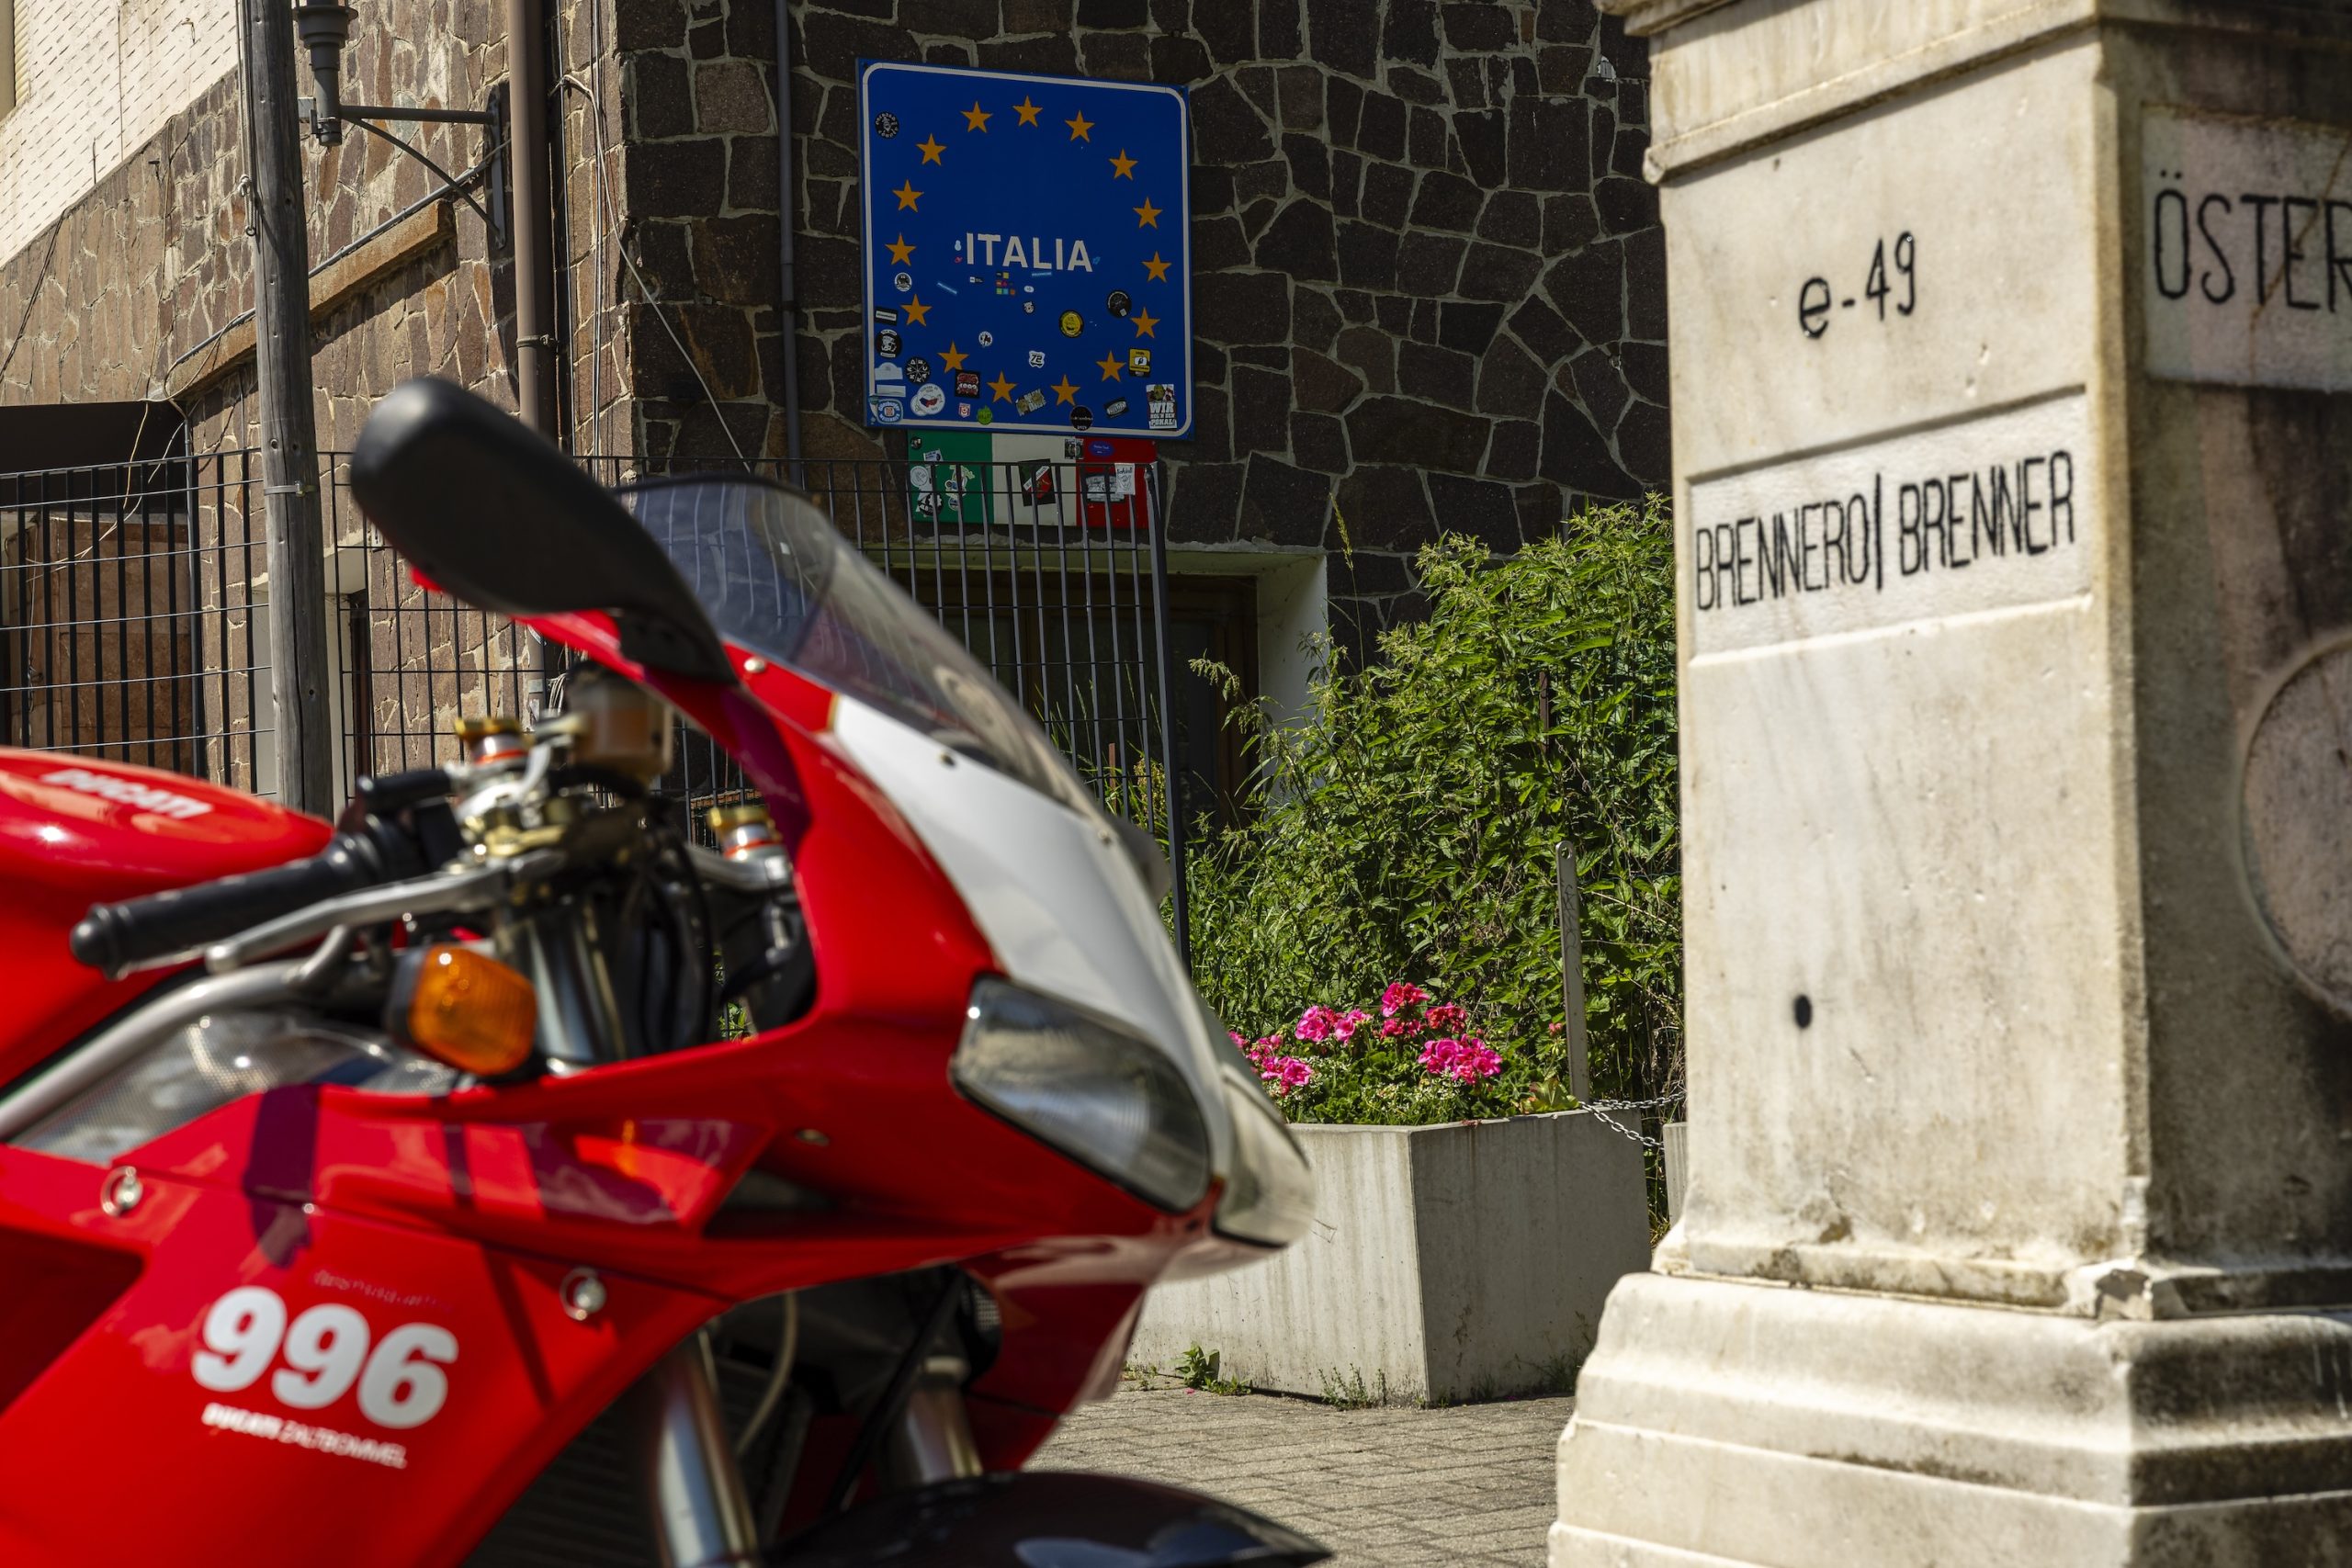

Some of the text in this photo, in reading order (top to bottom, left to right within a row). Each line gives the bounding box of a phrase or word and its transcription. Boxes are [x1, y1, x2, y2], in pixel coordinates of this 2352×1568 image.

[966, 232, 1093, 273] ITALIA
[1031, 355, 1042, 363] 72
[1148, 402, 1174, 413] WIR
[1696, 450, 2075, 611] BRENNERO BRENNER
[189, 1285, 459, 1429] 996
